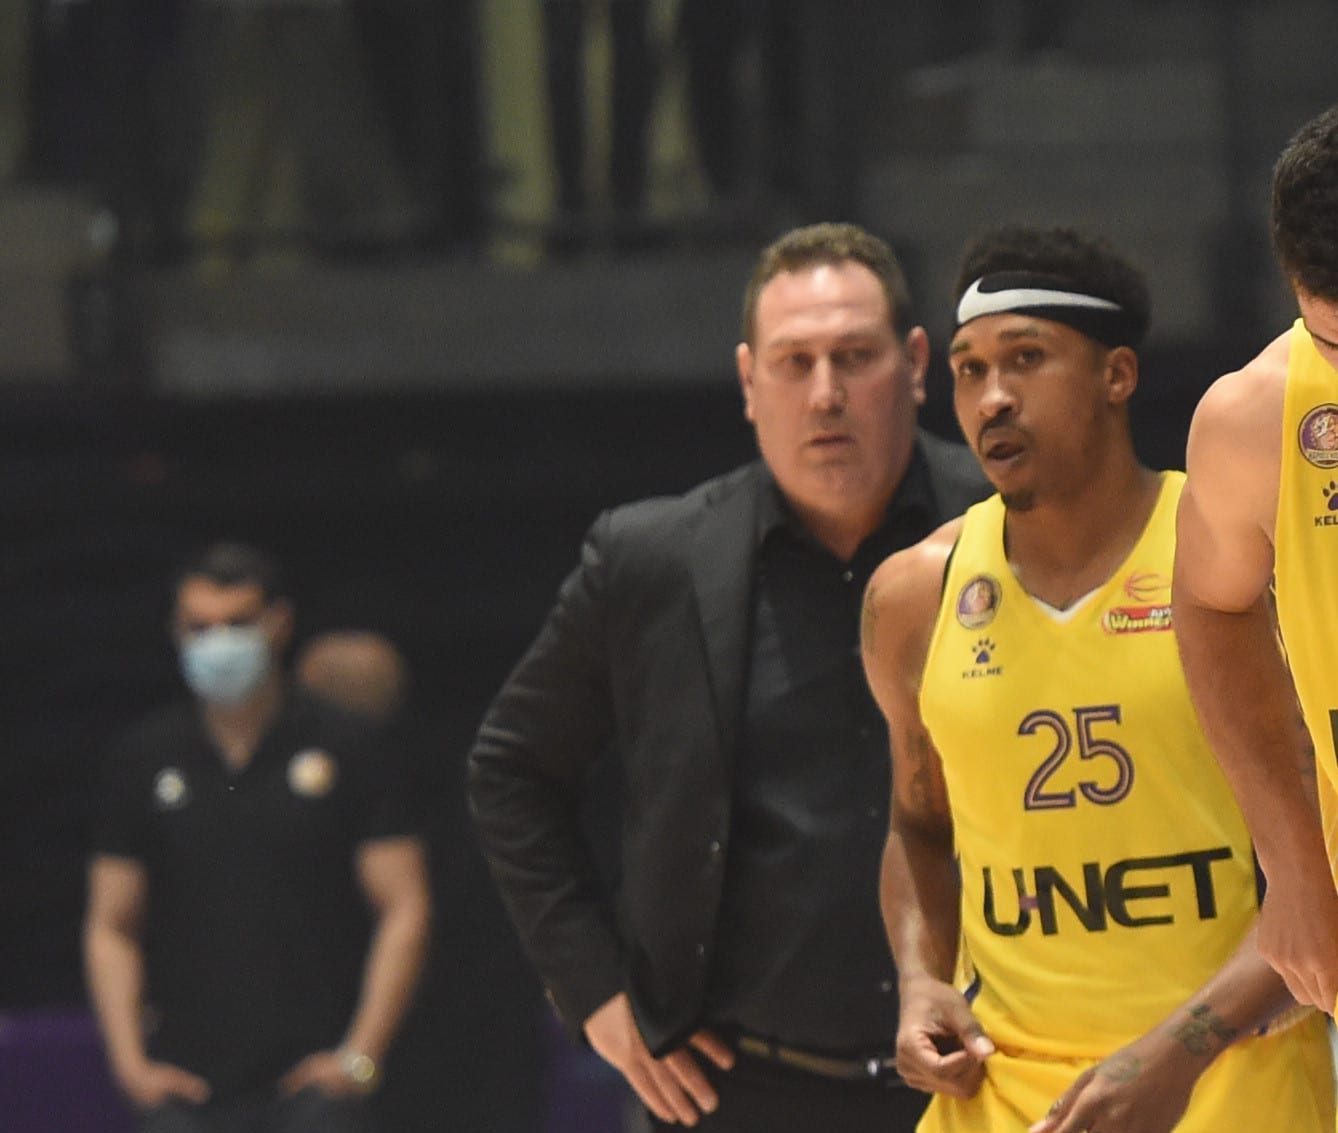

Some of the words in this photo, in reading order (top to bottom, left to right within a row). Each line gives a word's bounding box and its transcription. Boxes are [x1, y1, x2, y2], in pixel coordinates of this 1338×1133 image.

[962, 666, 1003, 679] KELME
[1018, 703, 1135, 811] 25
[982, 846, 1233, 936] UNET
